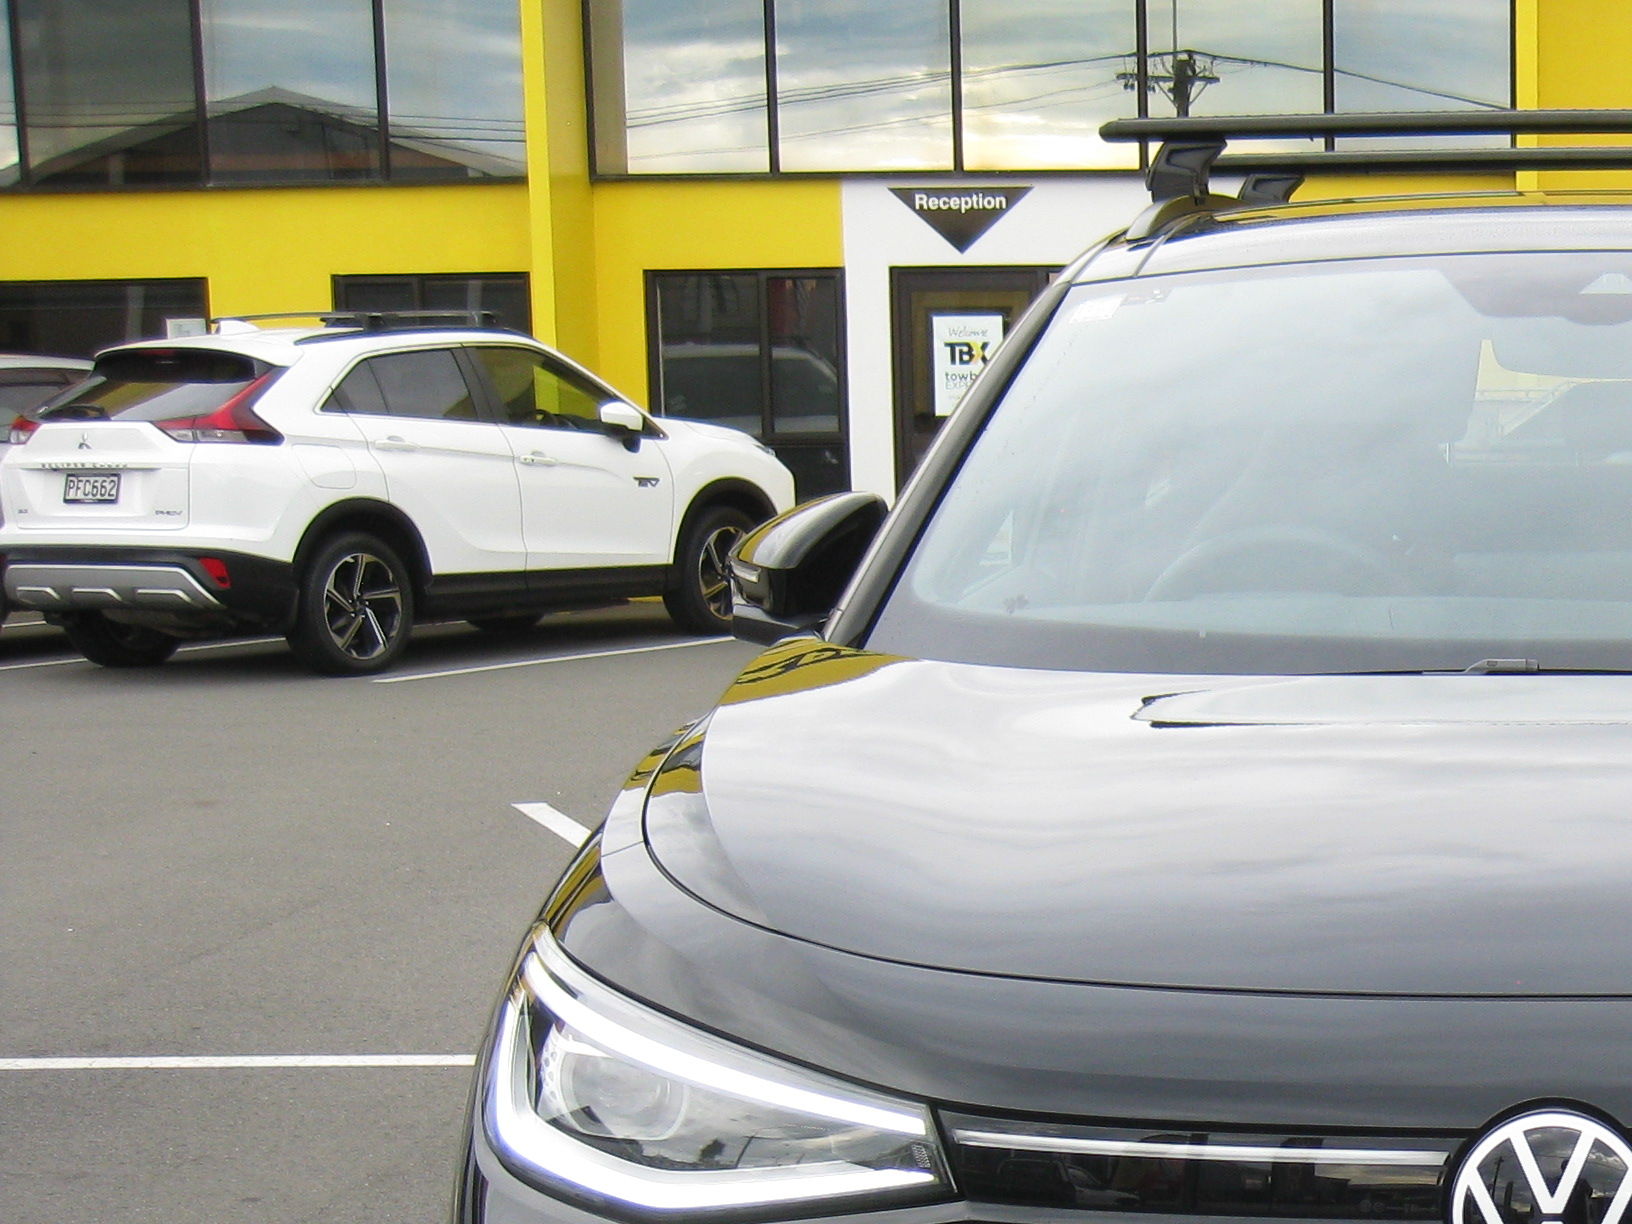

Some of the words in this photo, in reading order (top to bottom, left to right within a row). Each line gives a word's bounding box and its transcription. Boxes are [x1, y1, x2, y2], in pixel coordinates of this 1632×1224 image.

[914, 193, 1007, 214] Reception
[948, 326, 988, 337] Welcome
[944, 342, 990, 365] TBX
[945, 371, 978, 380] towb
[67, 479, 117, 497] PFC662
